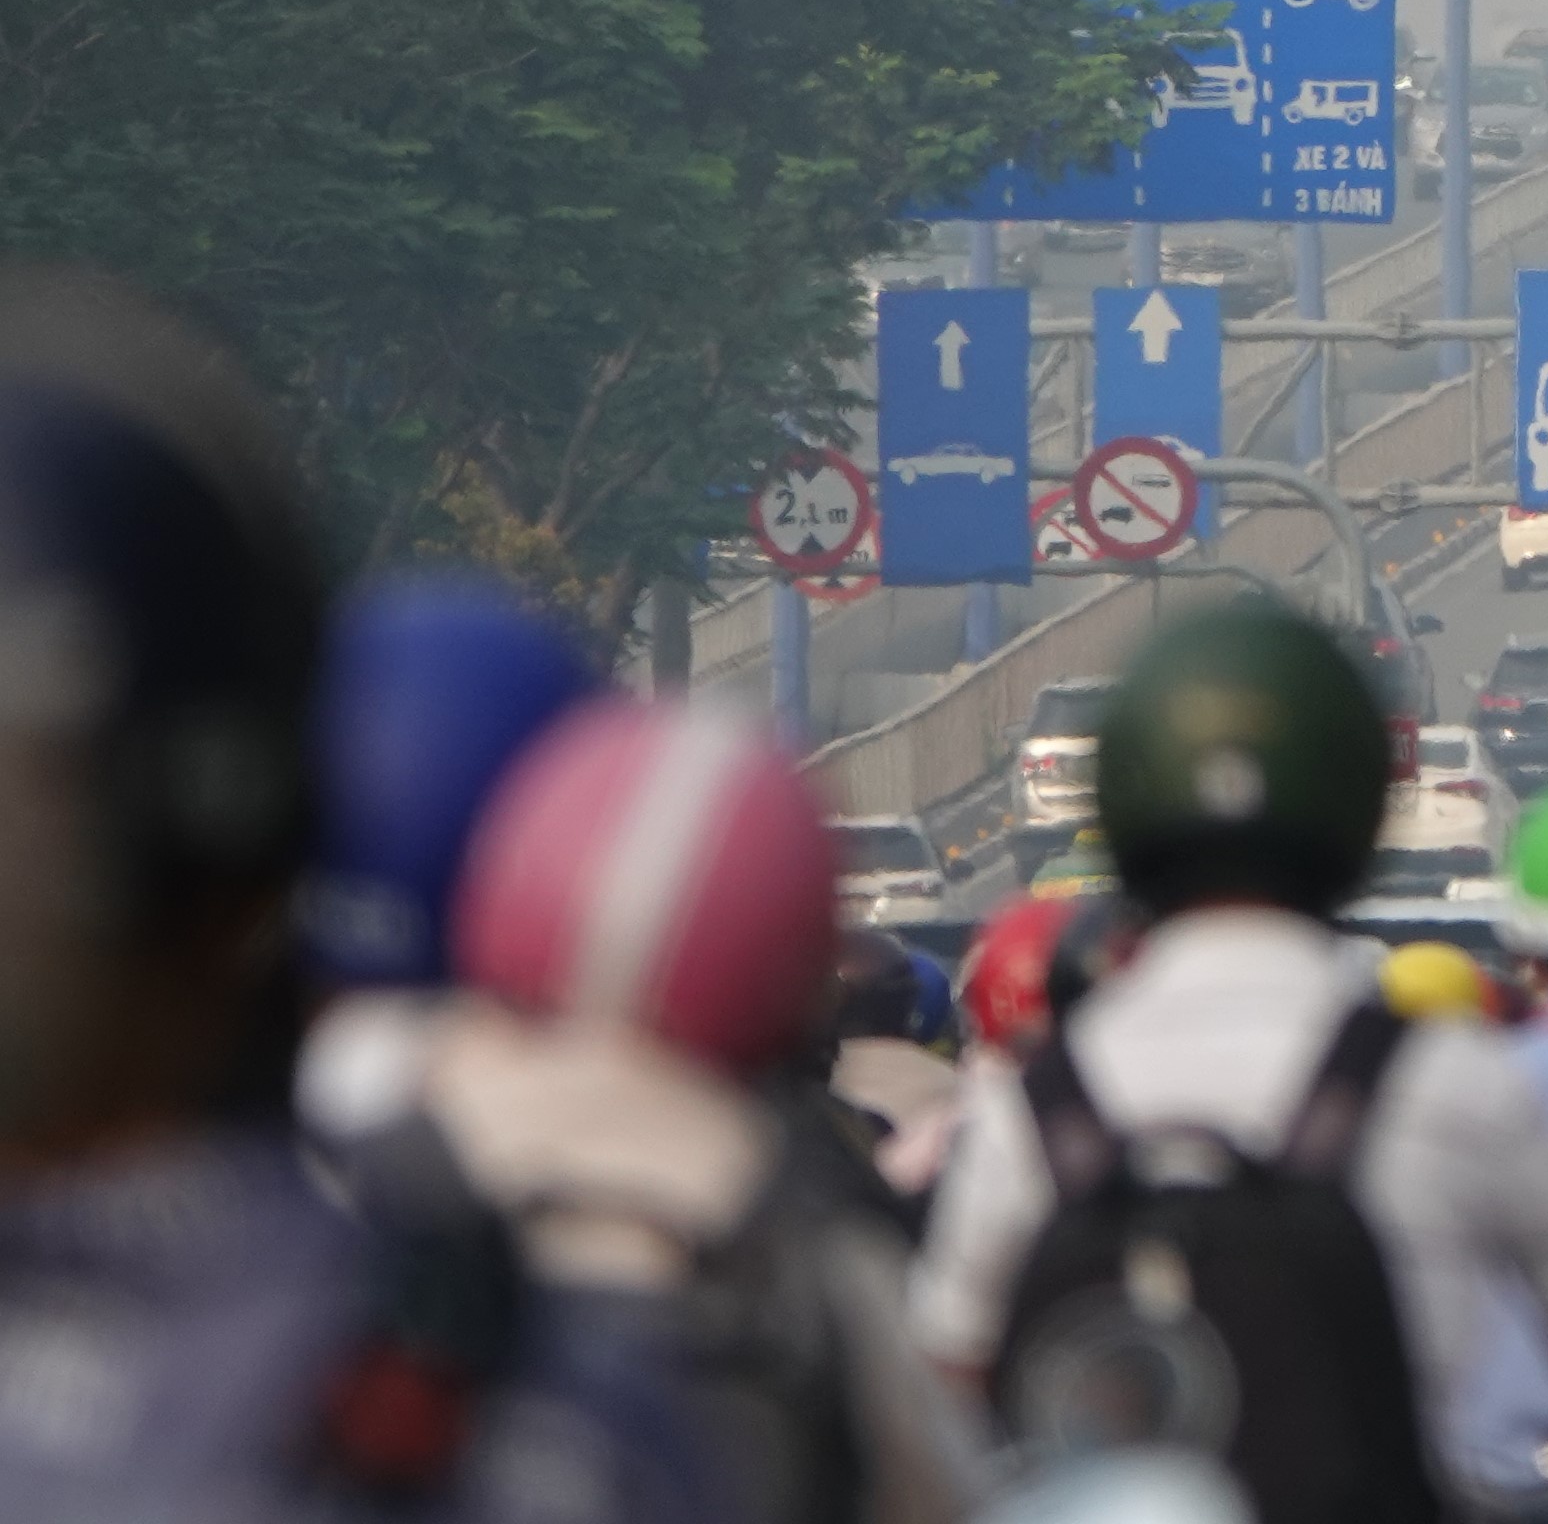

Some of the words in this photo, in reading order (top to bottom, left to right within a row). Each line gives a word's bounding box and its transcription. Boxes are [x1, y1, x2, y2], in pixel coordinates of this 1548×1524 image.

[1294, 145, 1327, 171] XE
[1333, 144, 1351, 169] 2
[1355, 139, 1387, 170] VÀ
[1295, 188, 1310, 212] 3
[1316, 180, 1383, 216] BÁNH
